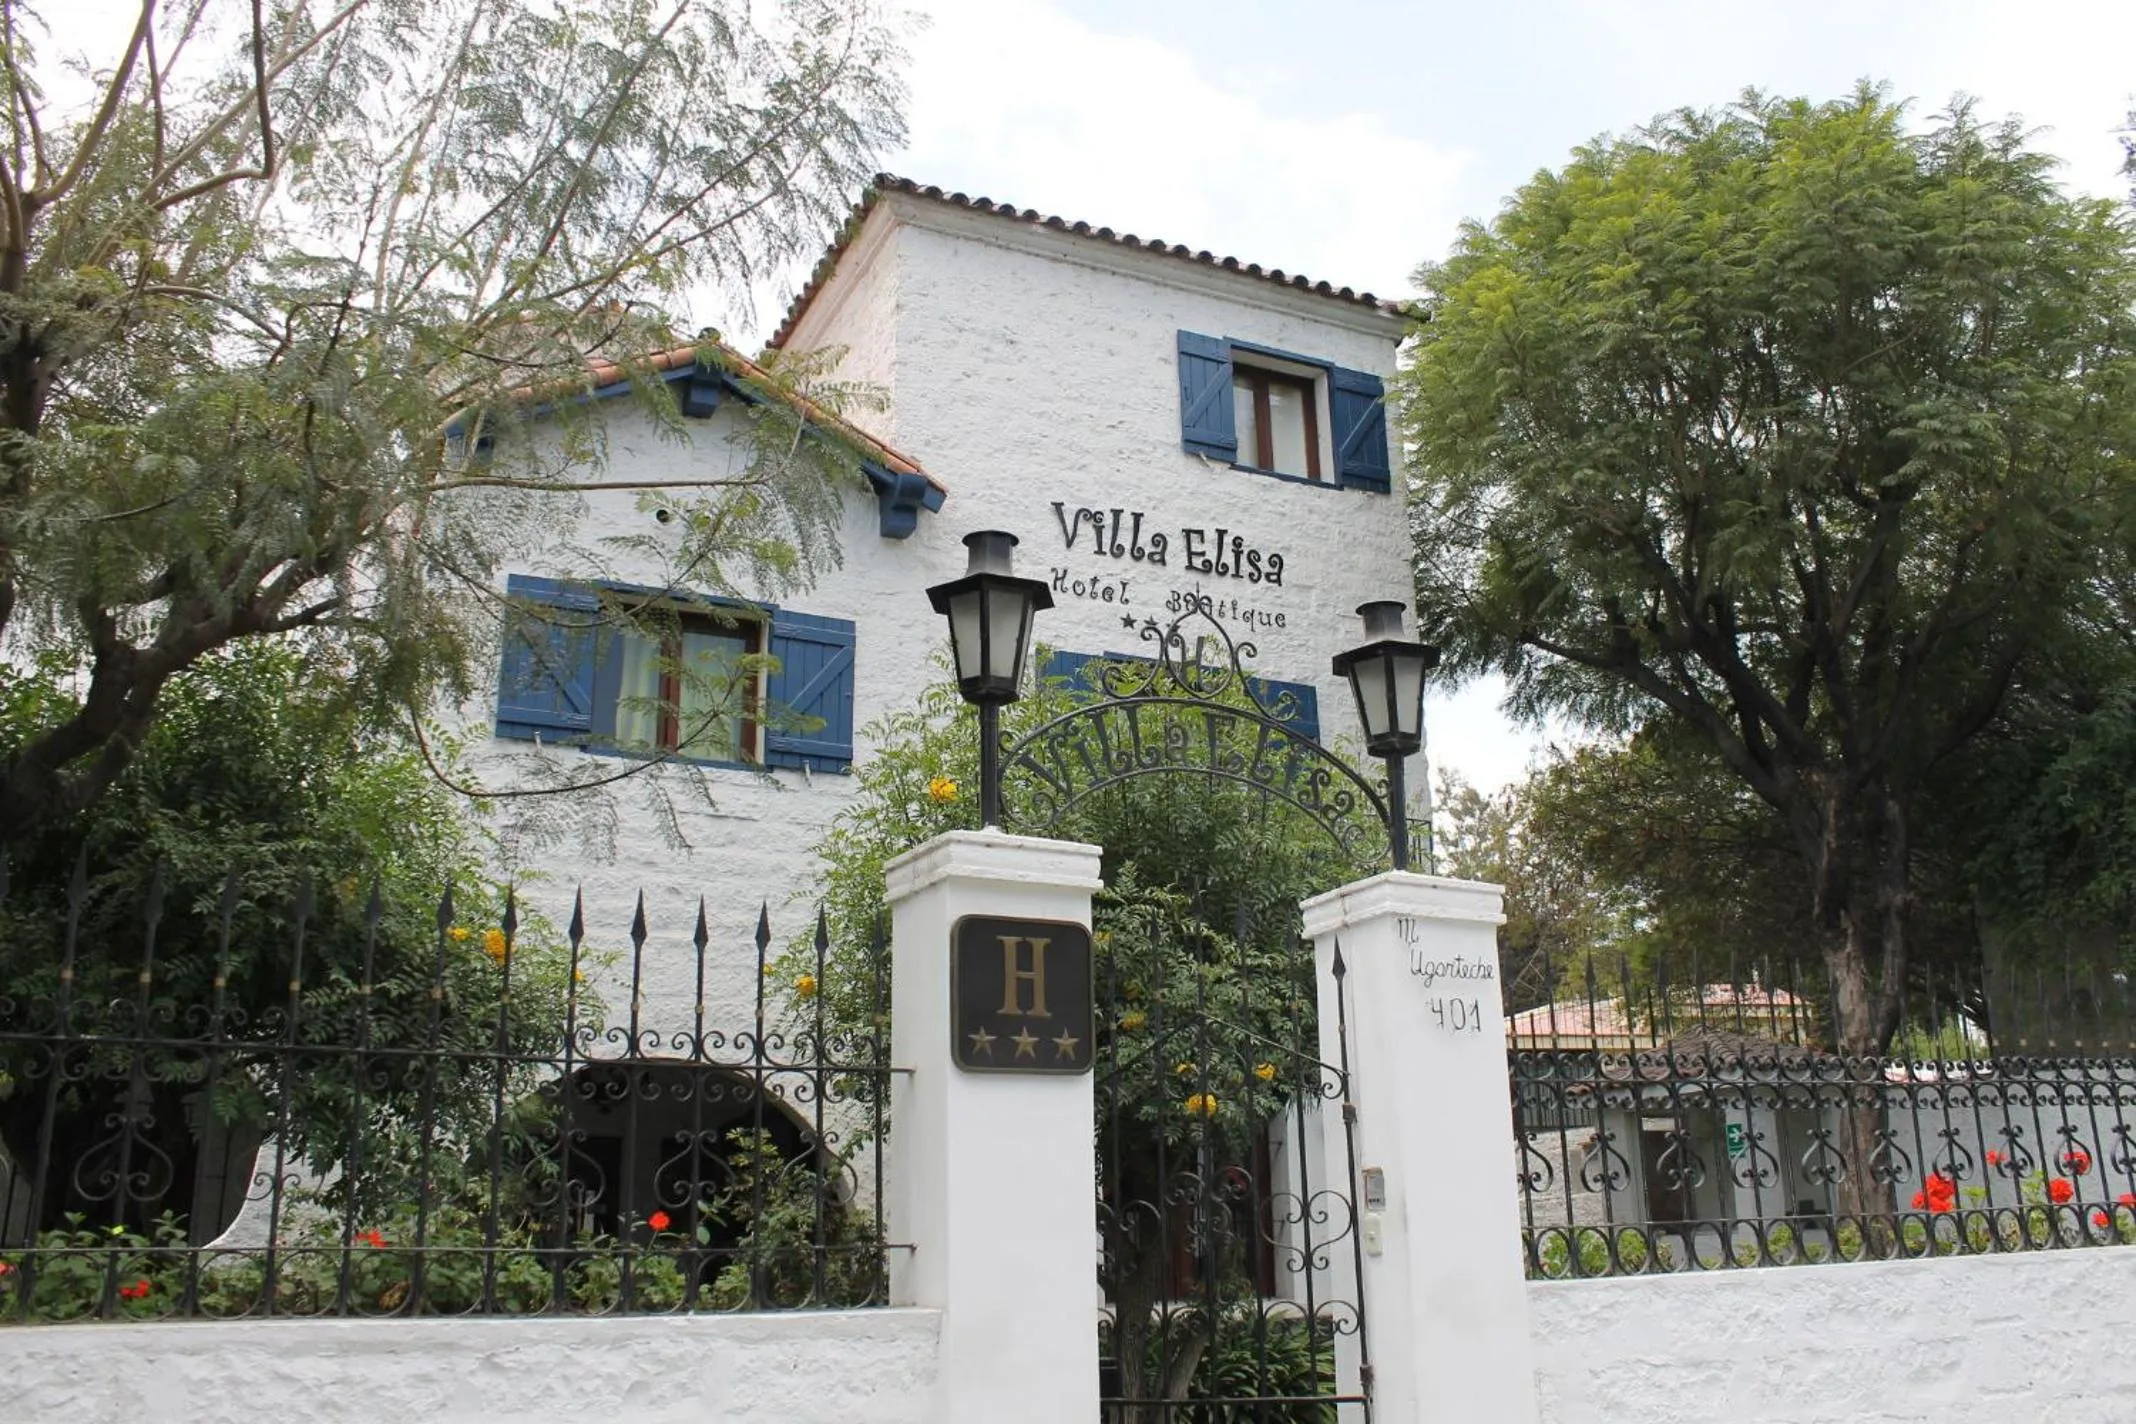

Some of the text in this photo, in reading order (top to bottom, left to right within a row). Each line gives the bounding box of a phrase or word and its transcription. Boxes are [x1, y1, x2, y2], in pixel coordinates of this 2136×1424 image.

[1050, 501, 1284, 586] Villa Elisa
[1051, 567, 1130, 605] Hotel
[995, 935, 1053, 1018] H
[1430, 997, 1481, 1032] 401
